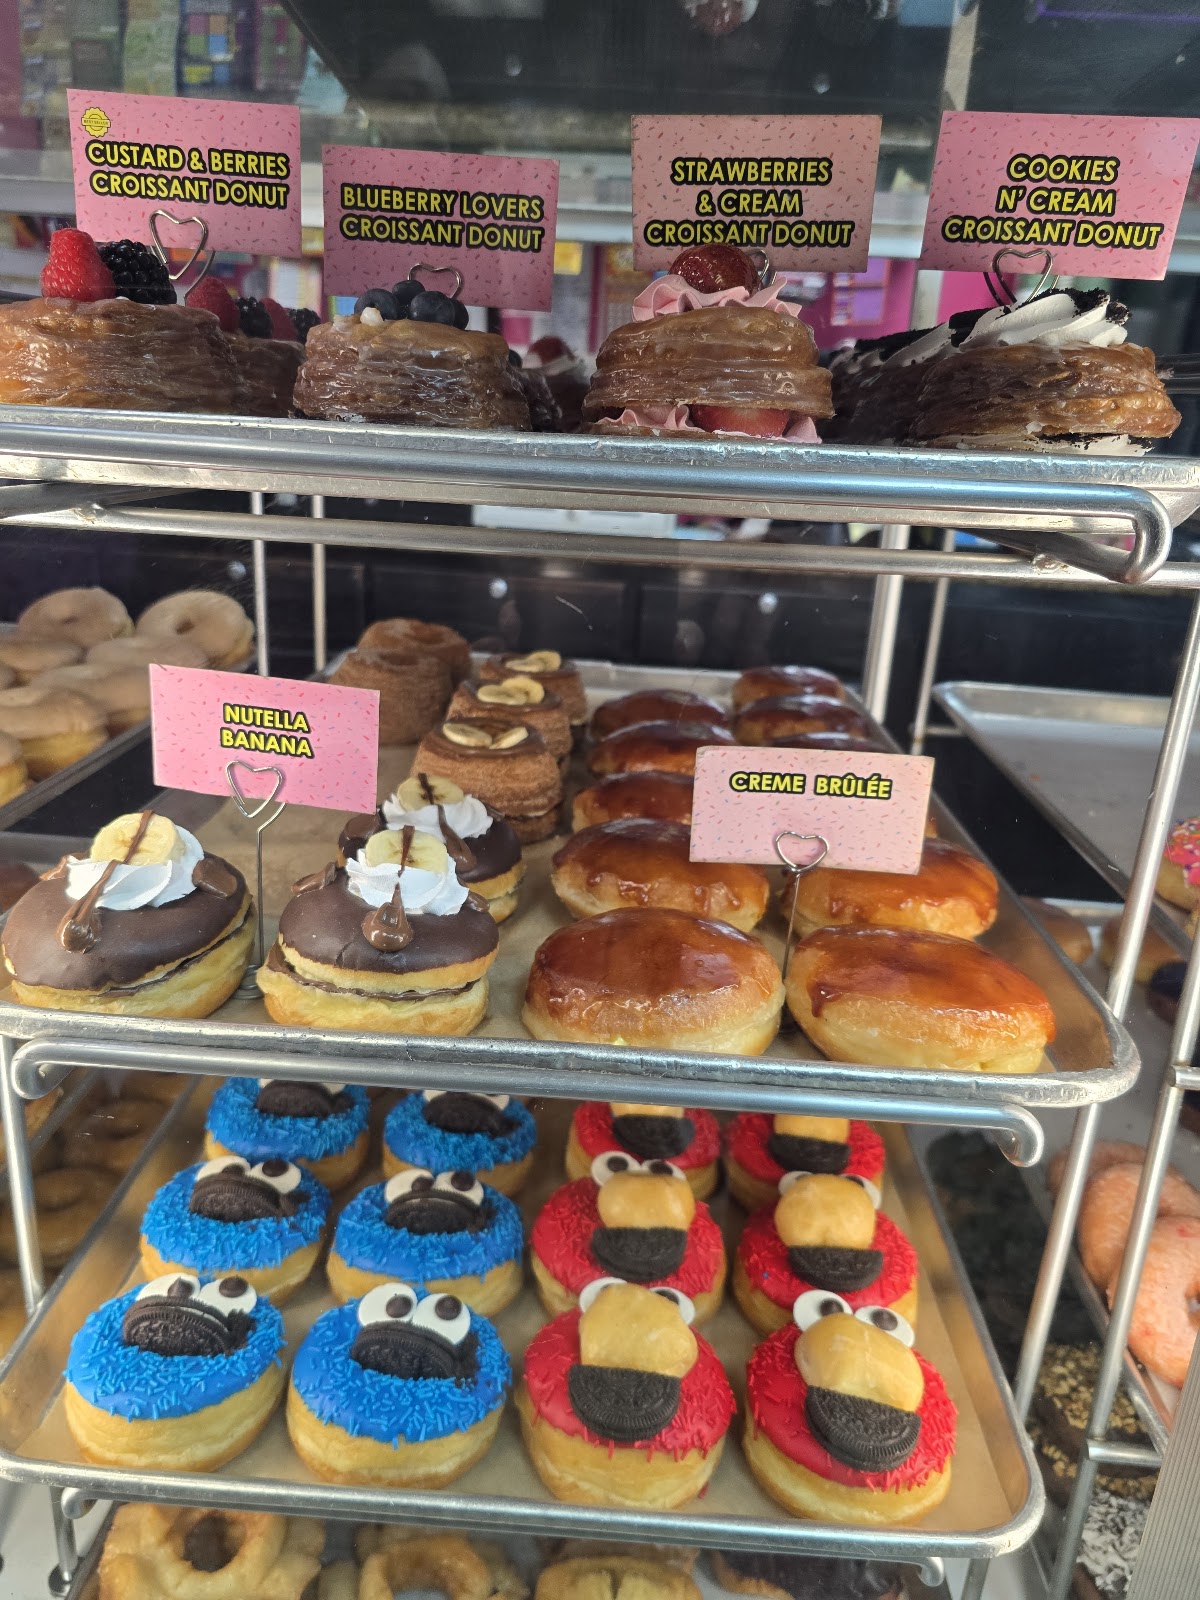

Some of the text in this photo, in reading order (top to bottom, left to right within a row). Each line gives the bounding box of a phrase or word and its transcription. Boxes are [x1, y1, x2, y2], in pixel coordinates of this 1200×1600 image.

[88, 142, 288, 178] CUSTARD & BERRIES
[672, 160, 831, 183] STRAWBERRIES
[1008, 156, 1117, 182] COOKIES
[91, 172, 287, 207] CROISSANT DONUT
[342, 186, 542, 220] BLUEBERRY LOVERS
[697, 192, 801, 214] & CREAM
[1029, 188, 1114, 214] CREAM
[341, 216, 542, 250] CROISSANT DONUT
[645, 222, 852, 246] CROISSANT DONUT
[943, 218, 1162, 247] CROISSANT DONUT
[223, 704, 310, 732] NUTELLA
[221, 728, 313, 757] BANANA
[730, 772, 891, 799] CREME BRÛLÉE
